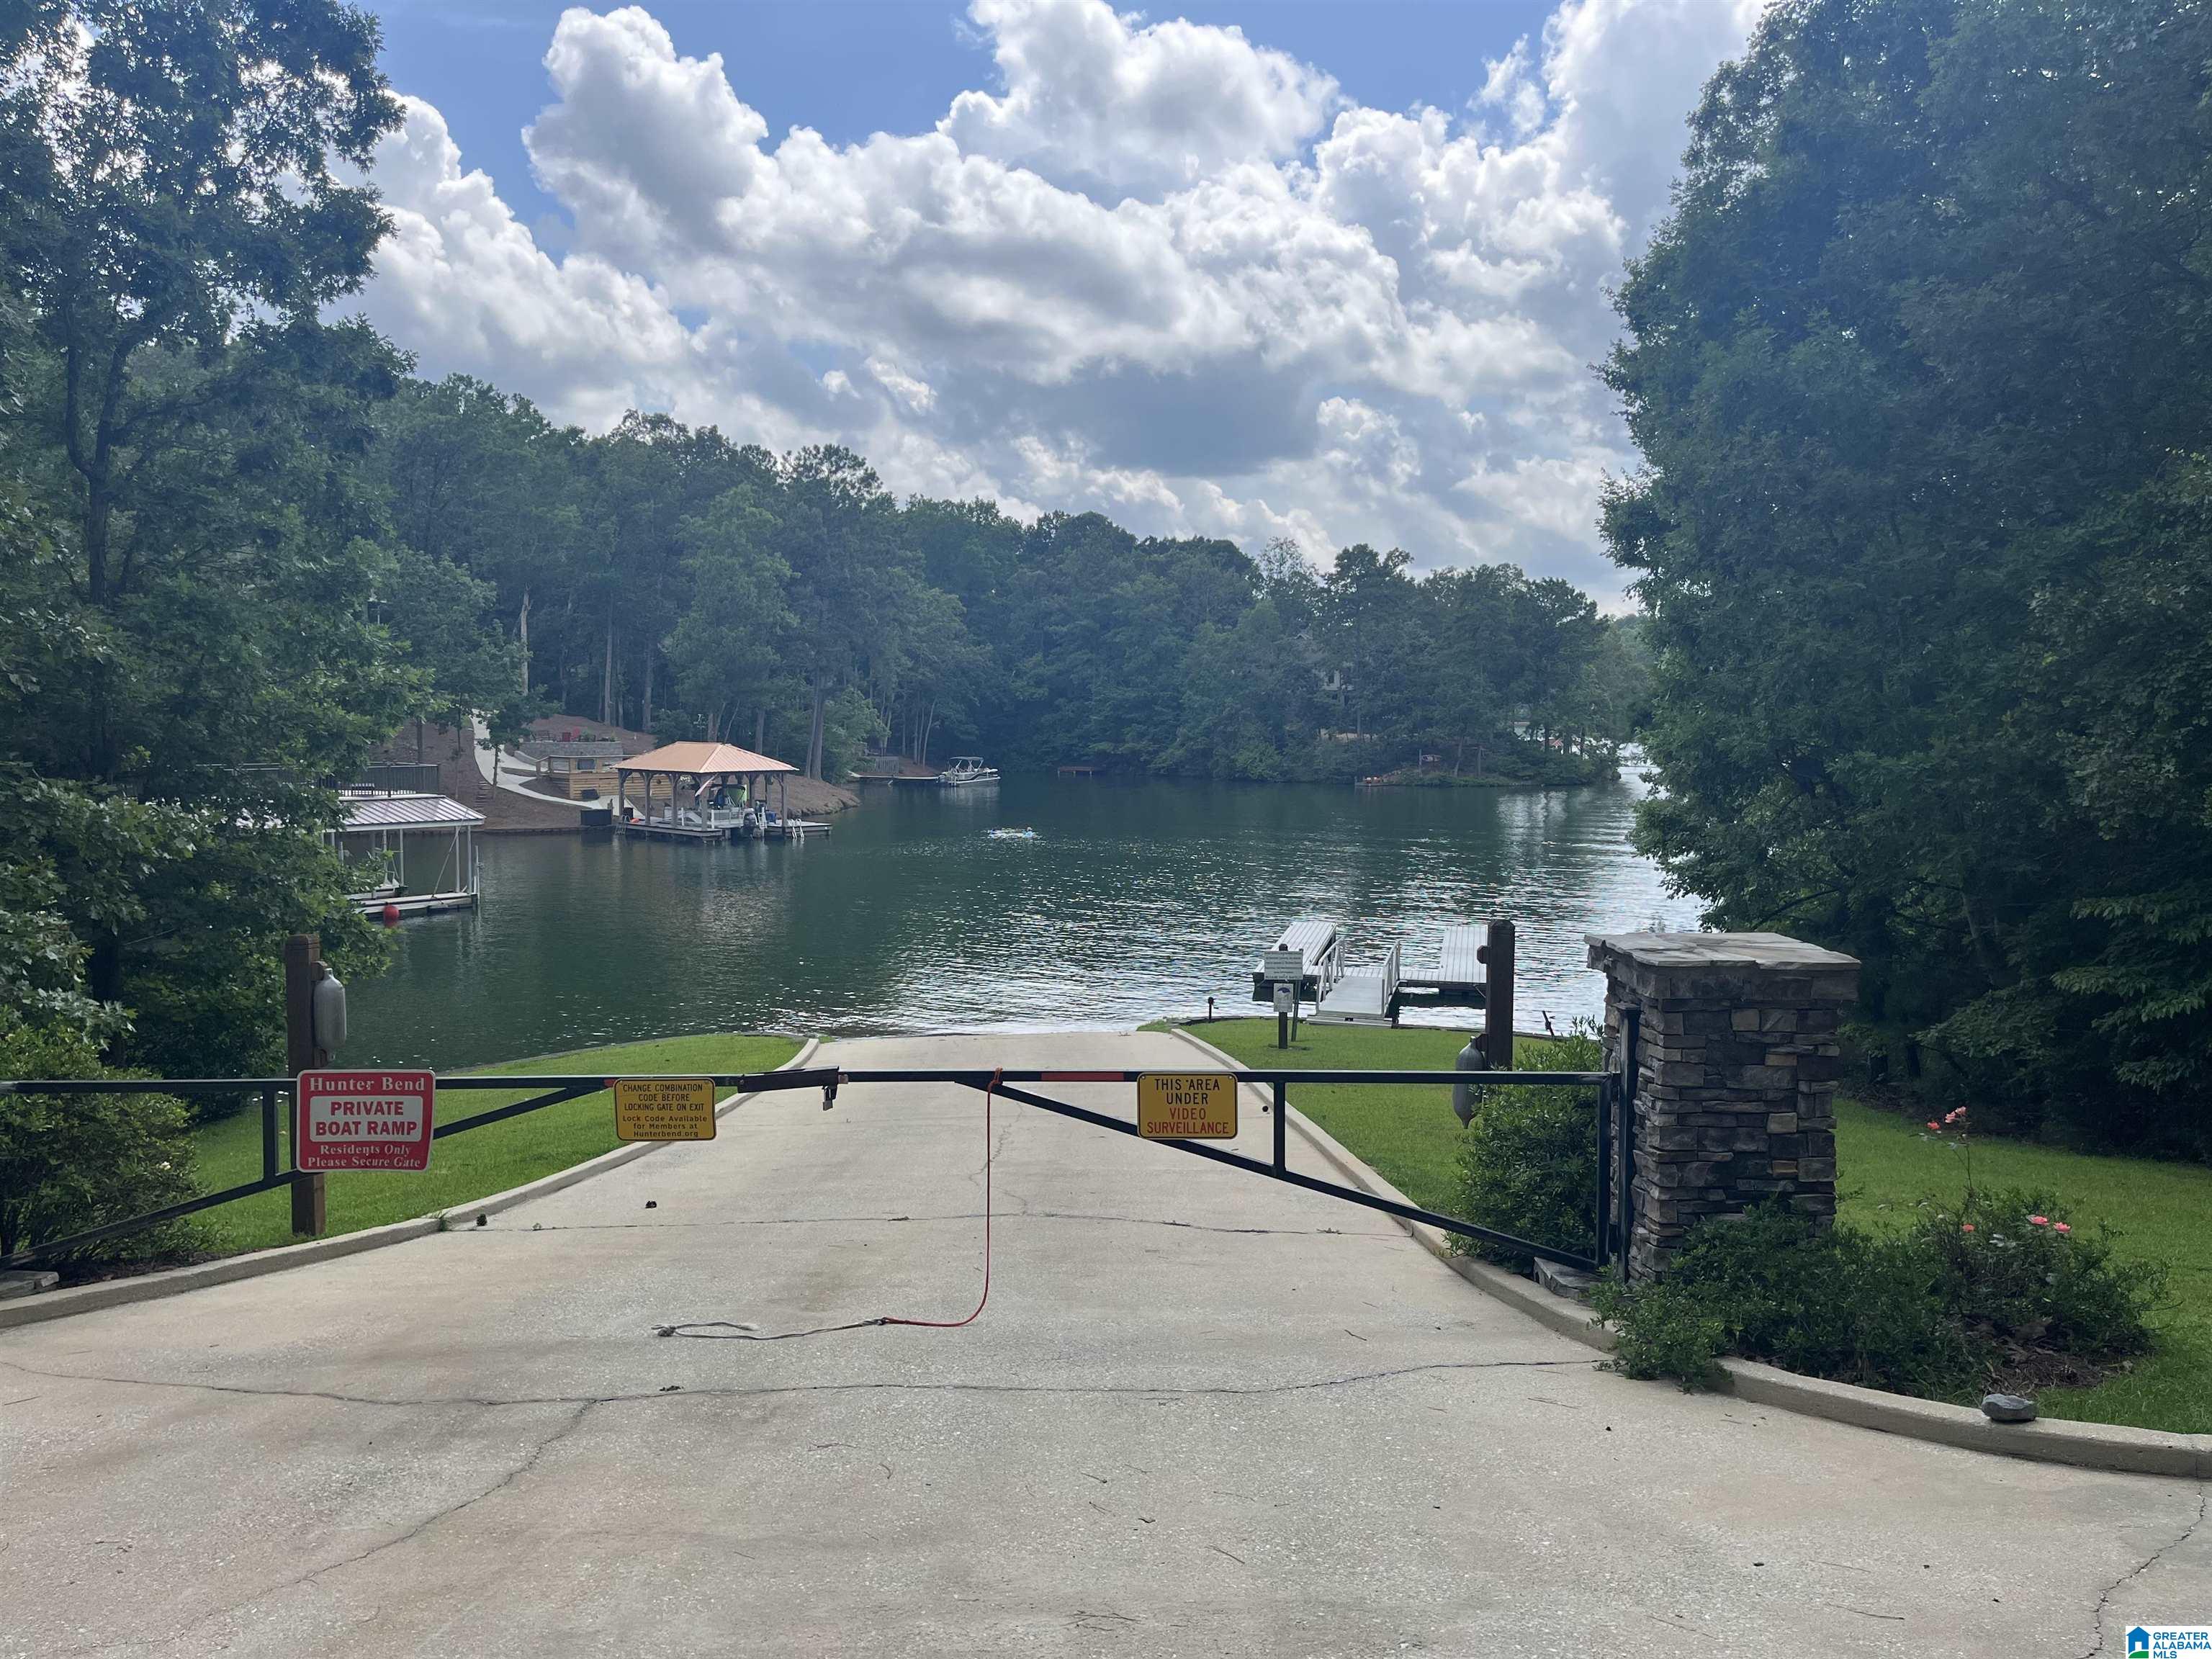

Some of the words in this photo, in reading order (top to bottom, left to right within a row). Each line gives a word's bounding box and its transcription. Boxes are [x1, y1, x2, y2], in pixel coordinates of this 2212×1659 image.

[309, 1077, 374, 1092] Hunter
[382, 1077, 425, 1091] Bend
[1155, 1079, 1181, 1090] THIS
[1189, 1079, 1220, 1090] AREA
[1166, 1093, 1208, 1105] UNDER
[331, 1102, 404, 1115] PRIVATE
[1170, 1108, 1206, 1120] VIDEO
[315, 1121, 361, 1136] BOAT
[367, 1121, 418, 1136] RAMP
[1147, 1122, 1228, 1133] SURVEILLANCE
[320, 1145, 380, 1154] Residents
[385, 1144, 411, 1155] Only
[308, 1157, 346, 1166] Please
[352, 1157, 390, 1166] Secure
[394, 1157, 420, 1167] Gate
